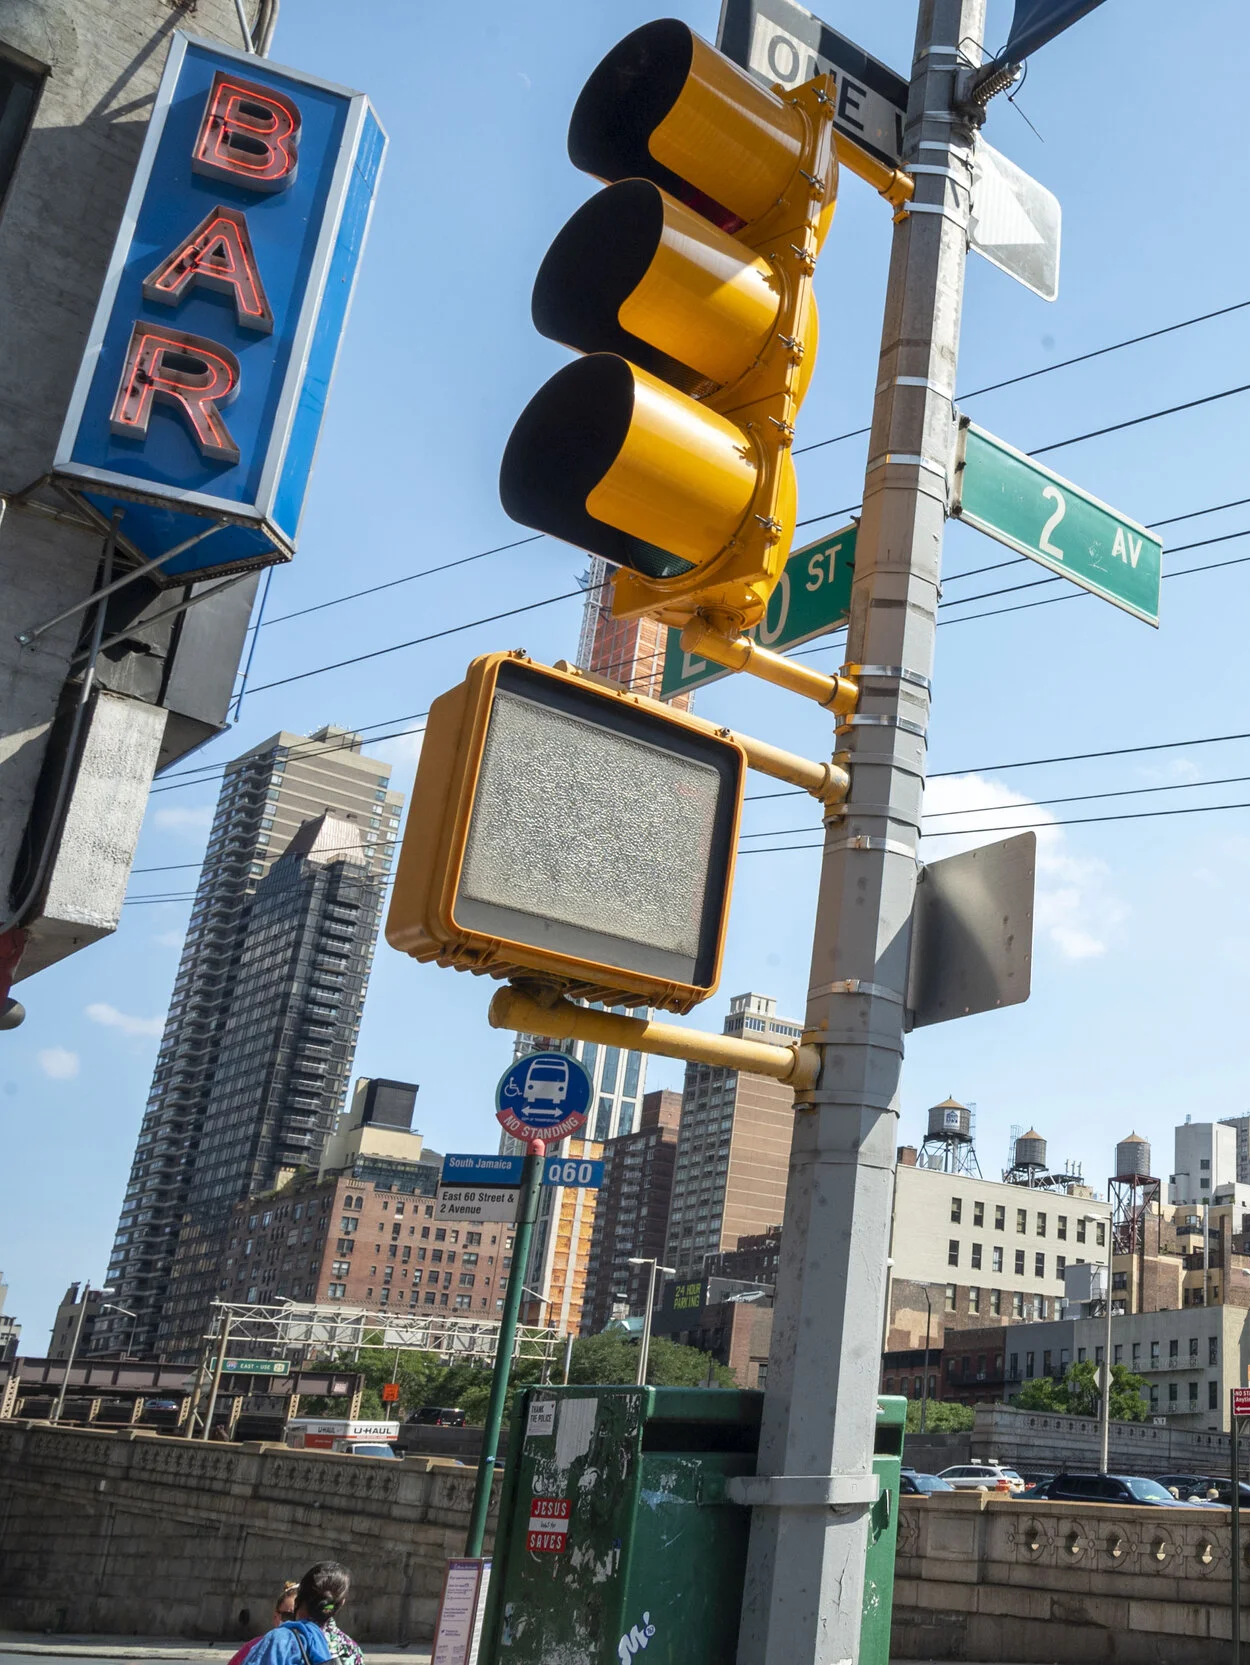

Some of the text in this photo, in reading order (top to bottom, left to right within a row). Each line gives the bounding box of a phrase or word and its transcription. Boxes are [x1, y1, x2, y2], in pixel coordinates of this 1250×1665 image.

[110, 71, 302, 465] BAR
[1039, 486, 1143, 568] 2 AV
[805, 544, 842, 591] ST
[504, 1115, 579, 1139] NO STANDING
[449, 1157, 512, 1170] South Jamaica
[549, 1162, 593, 1183] Q60
[442, 1191, 514, 1203] East 60 Street &
[440, 1204, 481, 1214] 2 Avenue
[675, 1285, 685, 1298] 24
[673, 1295, 700, 1310] PARKING
[534, 1501, 567, 1516] JESUS
[530, 1534, 562, 1549] SAVES
